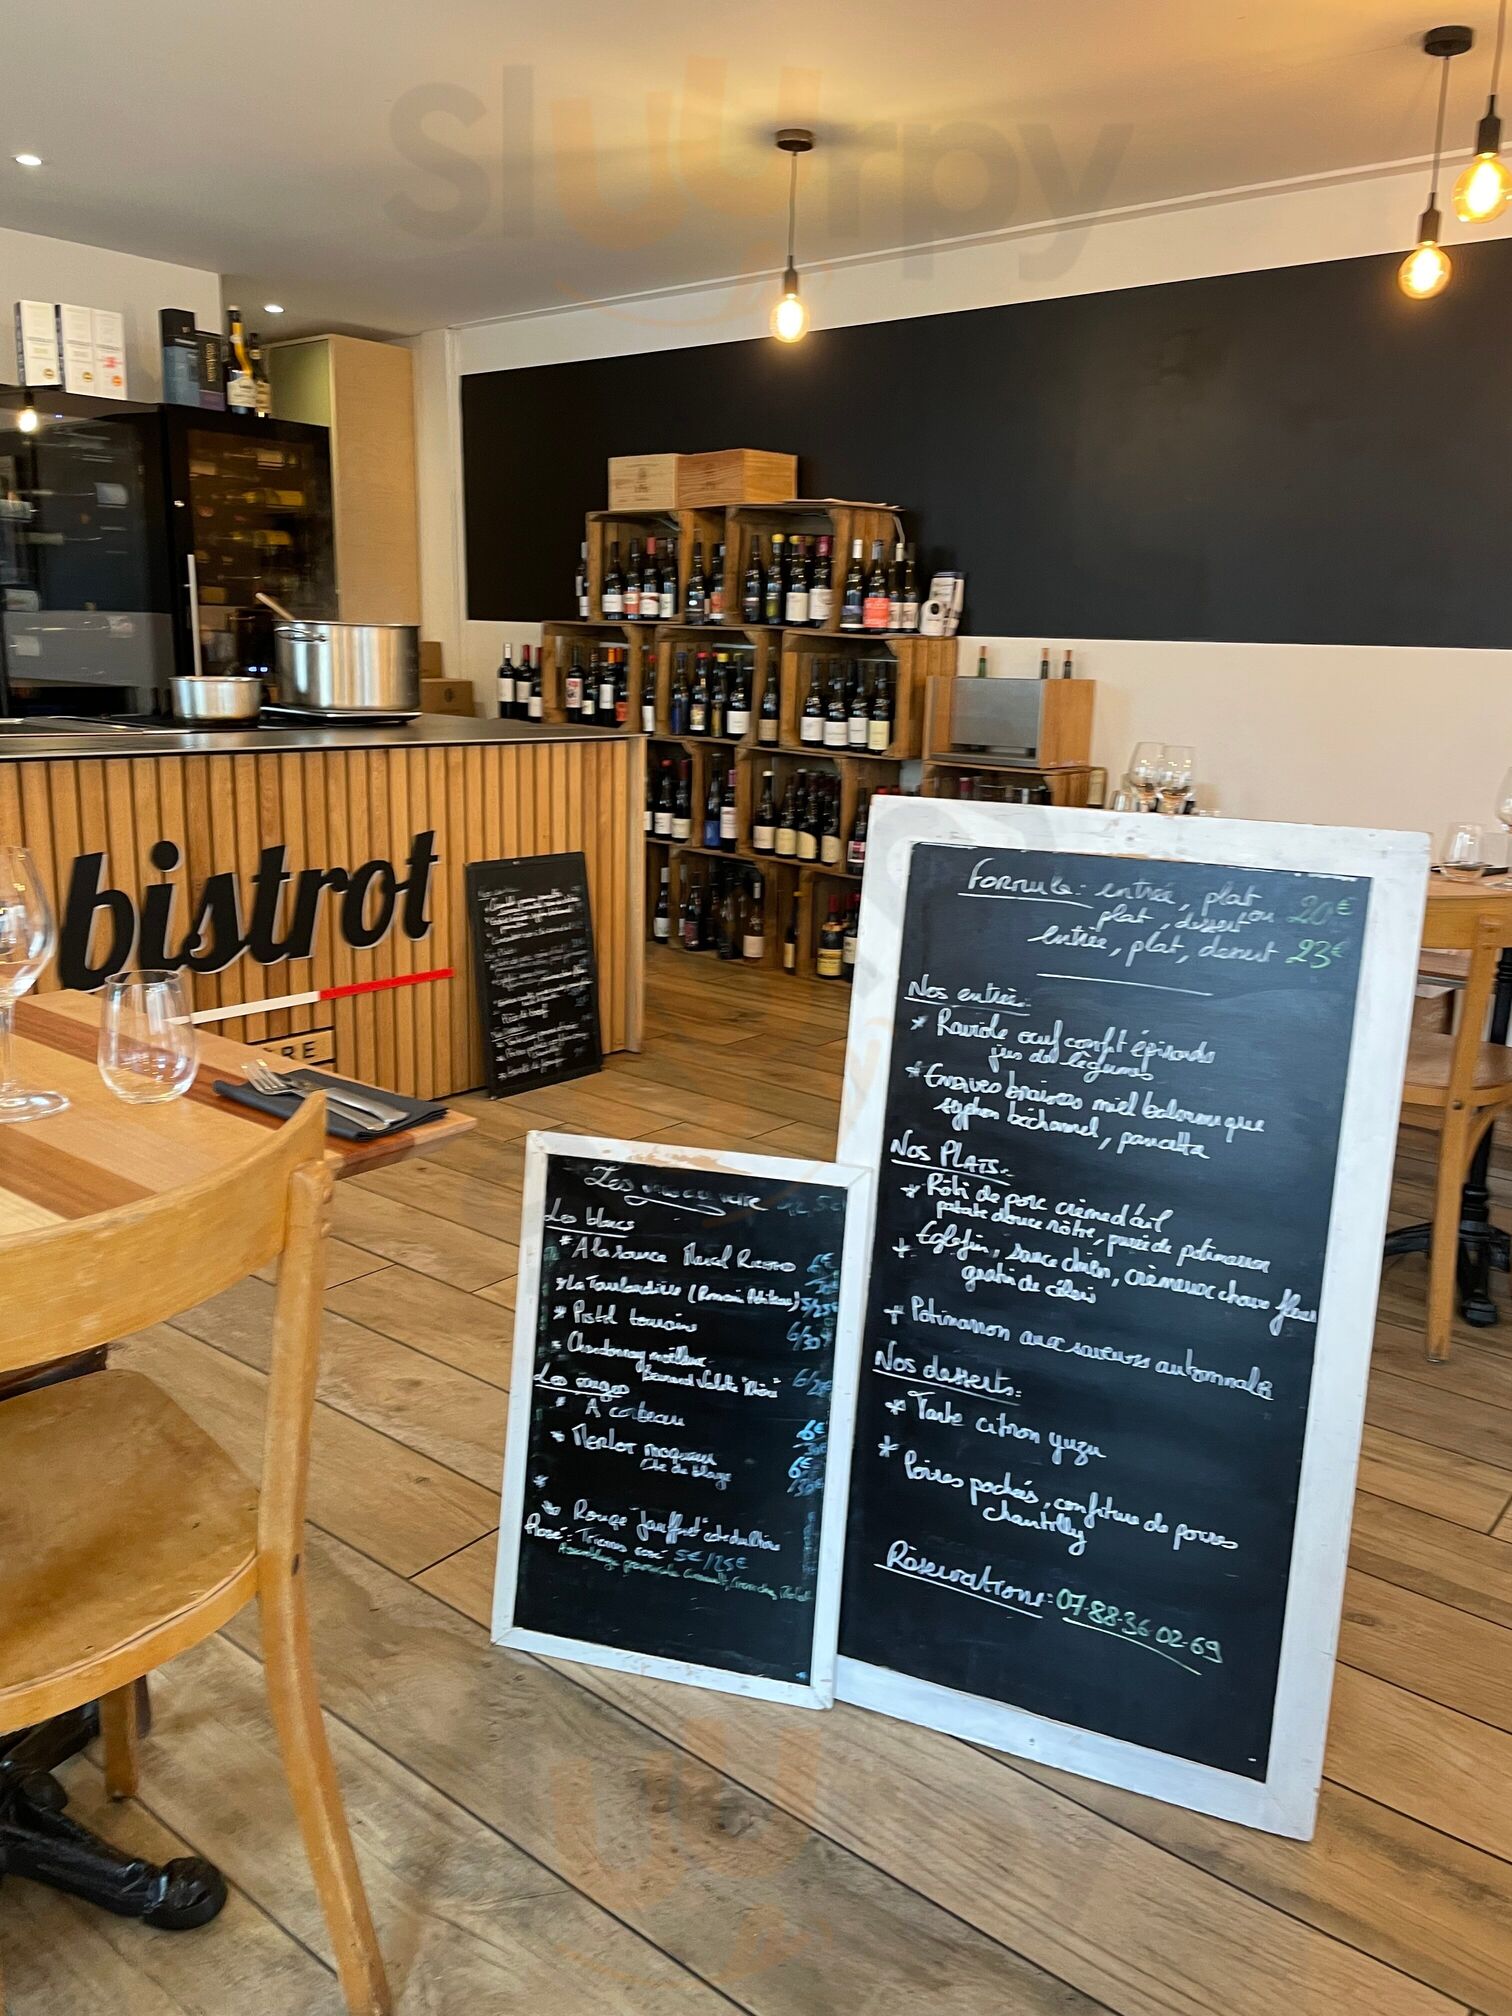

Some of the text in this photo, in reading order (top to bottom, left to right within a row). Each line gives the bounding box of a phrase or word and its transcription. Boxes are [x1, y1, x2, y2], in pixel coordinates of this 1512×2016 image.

[58, 829, 440, 992] bistrot
[1285, 937, 1350, 969] 23€
[908, 974, 948, 999] Nos
[988, 1044, 1023, 1073] jus
[1092, 1091, 1139, 1116] miel
[890, 1129, 931, 1160] Nos
[927, 1173, 970, 1199] Rôti
[976, 1185, 1000, 1204] de
[1004, 1194, 1048, 1216] porc
[1005, 1243, 1058, 1267] sauce
[1151, 1238, 1172, 1254] de
[962, 1262, 1016, 1292] gratin
[1018, 1275, 1041, 1292] de
[875, 1341, 917, 1373] Nos
[907, 1391, 1107, 1465] Tarte citron yuzu
[904, 1450, 964, 1487] Poires
[1144, 1513, 1169, 1533] de
[574, 1499, 628, 1531] Rouge
[983, 1500, 1087, 1556] chantilly
